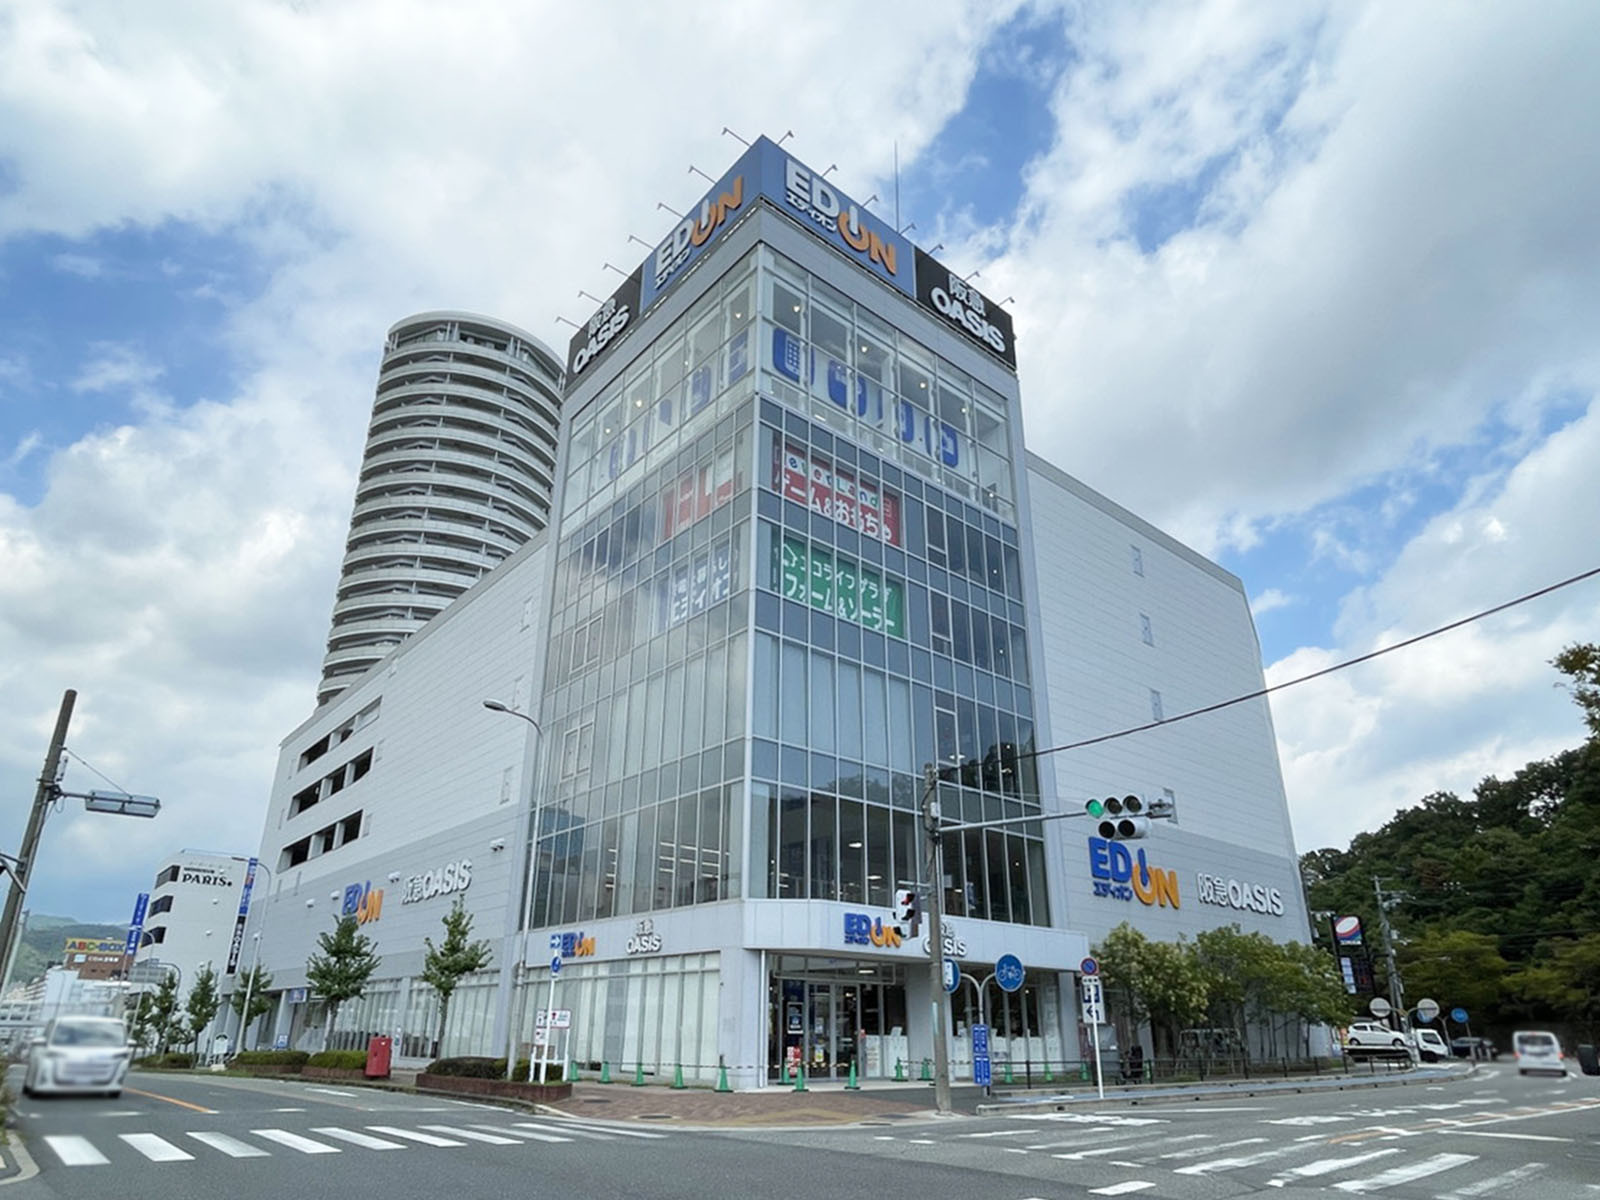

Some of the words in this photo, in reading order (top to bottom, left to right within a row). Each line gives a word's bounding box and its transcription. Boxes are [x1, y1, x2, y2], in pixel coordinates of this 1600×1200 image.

[786, 158, 897, 275] EDION
[573, 305, 630, 374] OASIS
[930, 286, 1006, 353] OASIS
[1088, 836, 1180, 910] EDION
[626, 935, 662, 955] OASIS
[923, 937, 967, 958] OSIS
